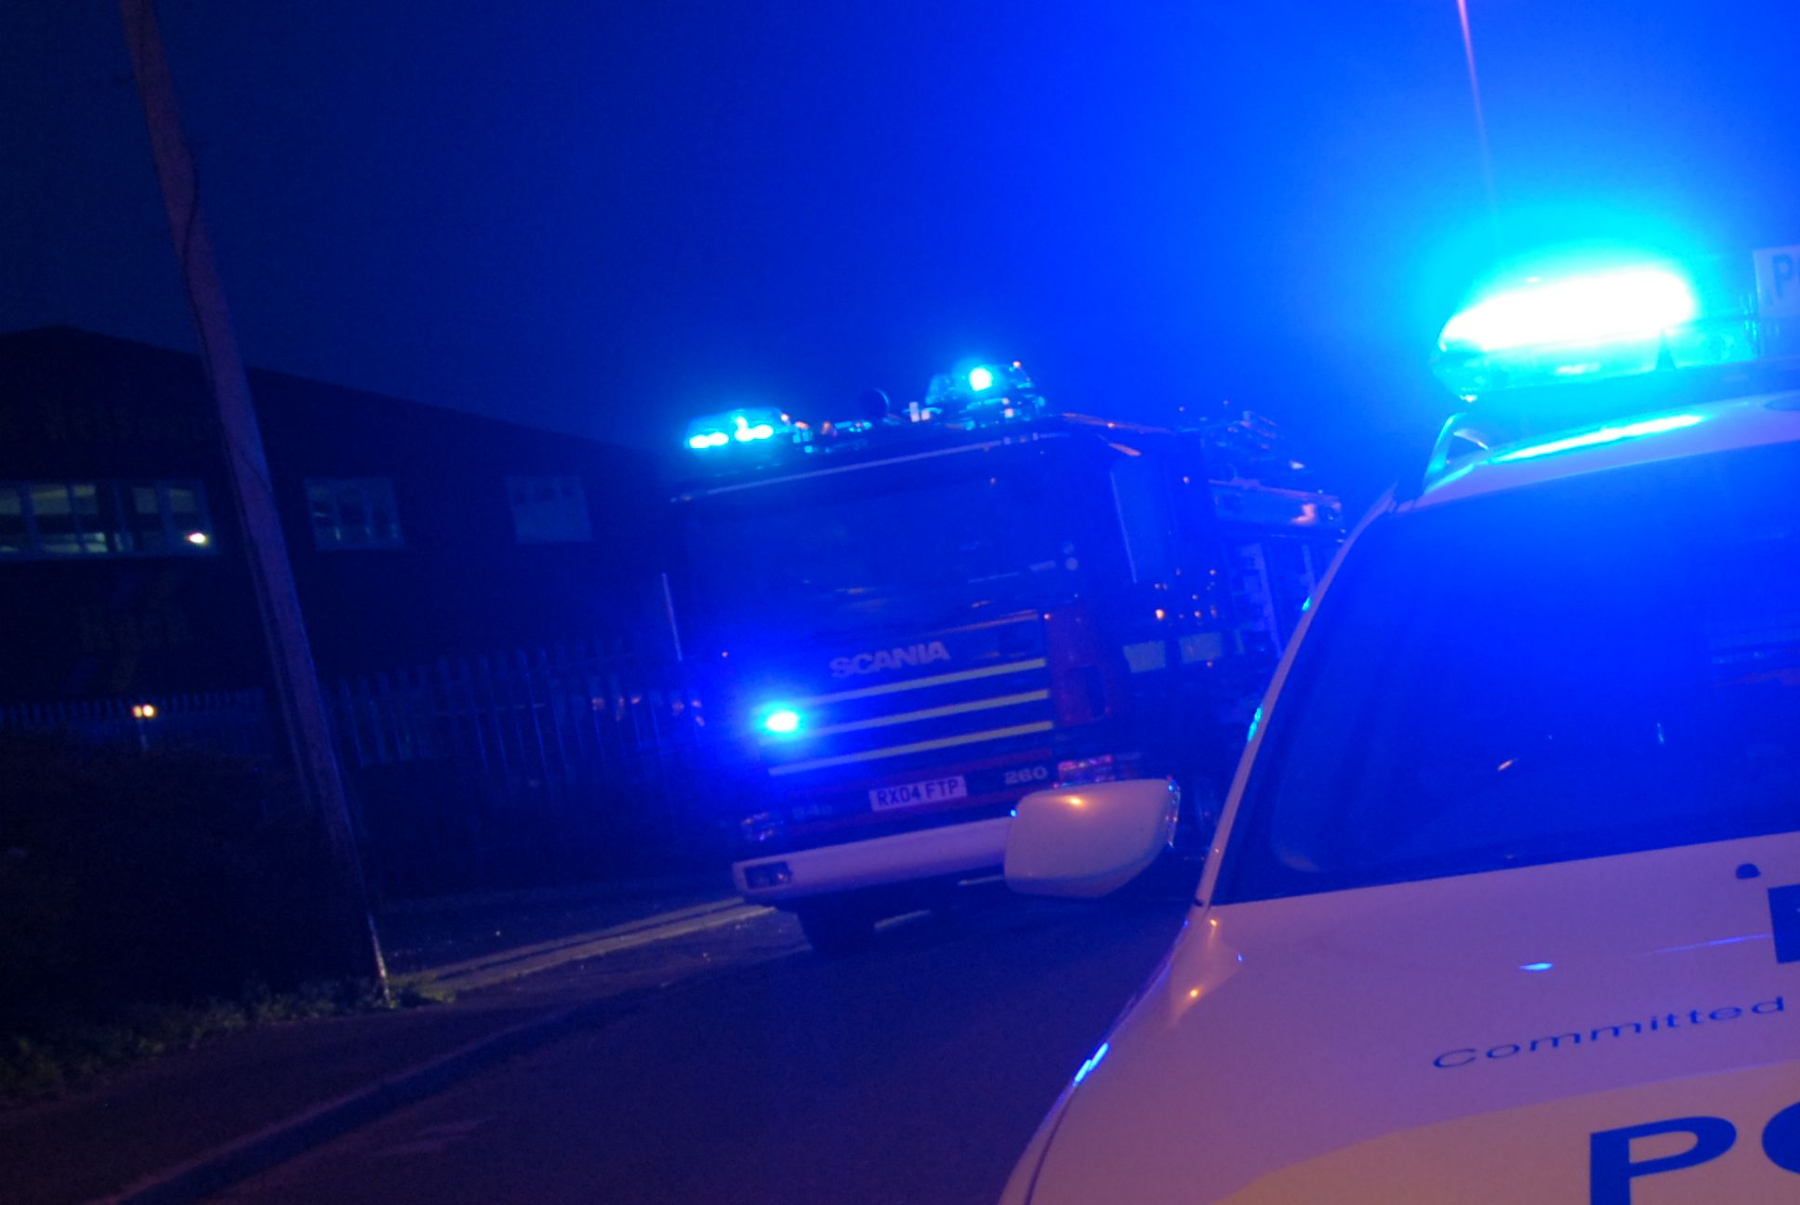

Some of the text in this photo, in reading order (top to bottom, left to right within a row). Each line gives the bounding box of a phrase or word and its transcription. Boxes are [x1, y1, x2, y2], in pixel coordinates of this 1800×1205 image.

[829, 640, 950, 678] SCANIA
[1004, 765, 1048, 785] 260
[877, 777, 959, 808] RX04 FTP
[1432, 996, 1784, 1068] Committed
